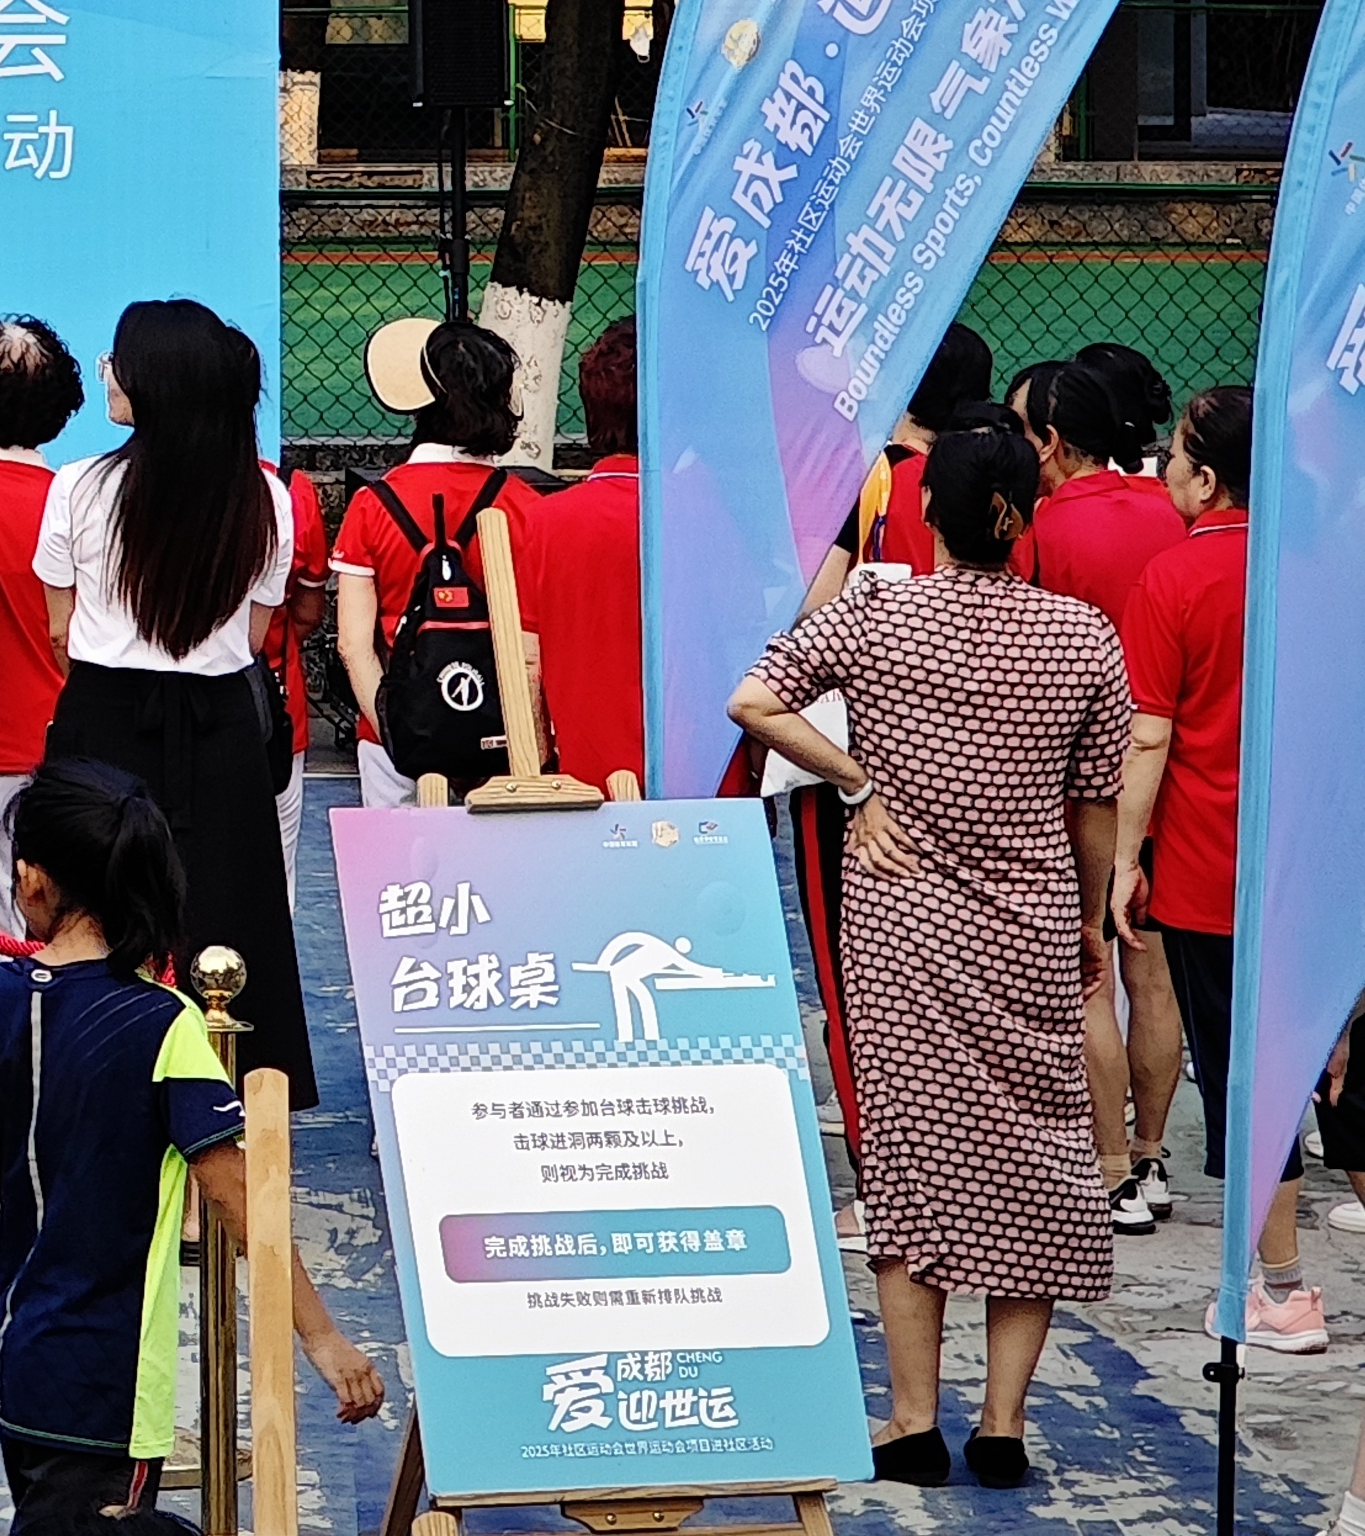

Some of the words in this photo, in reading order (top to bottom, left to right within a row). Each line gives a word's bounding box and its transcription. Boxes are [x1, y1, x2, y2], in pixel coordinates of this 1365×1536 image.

[806, 119, 955, 358] 运动无限
[833, 272, 925, 422] Boundless
[912, 173, 983, 281] Sports,
[968, 30, 1060, 172] Countless
[378, 881, 492, 940] 超小
[391, 951, 561, 1014] 台球桌
[541, 1161, 669, 1183] 则视为完成挑战
[527, 1286, 723, 1309] 挑战失败则需重新排队挑战
[616, 1351, 673, 1382] 成都
[676, 1351, 723, 1364] CHENG
[679, 1366, 699, 1379] DU
[542, 1353, 615, 1433] 爱
[617, 1386, 740, 1432] 迎世运
